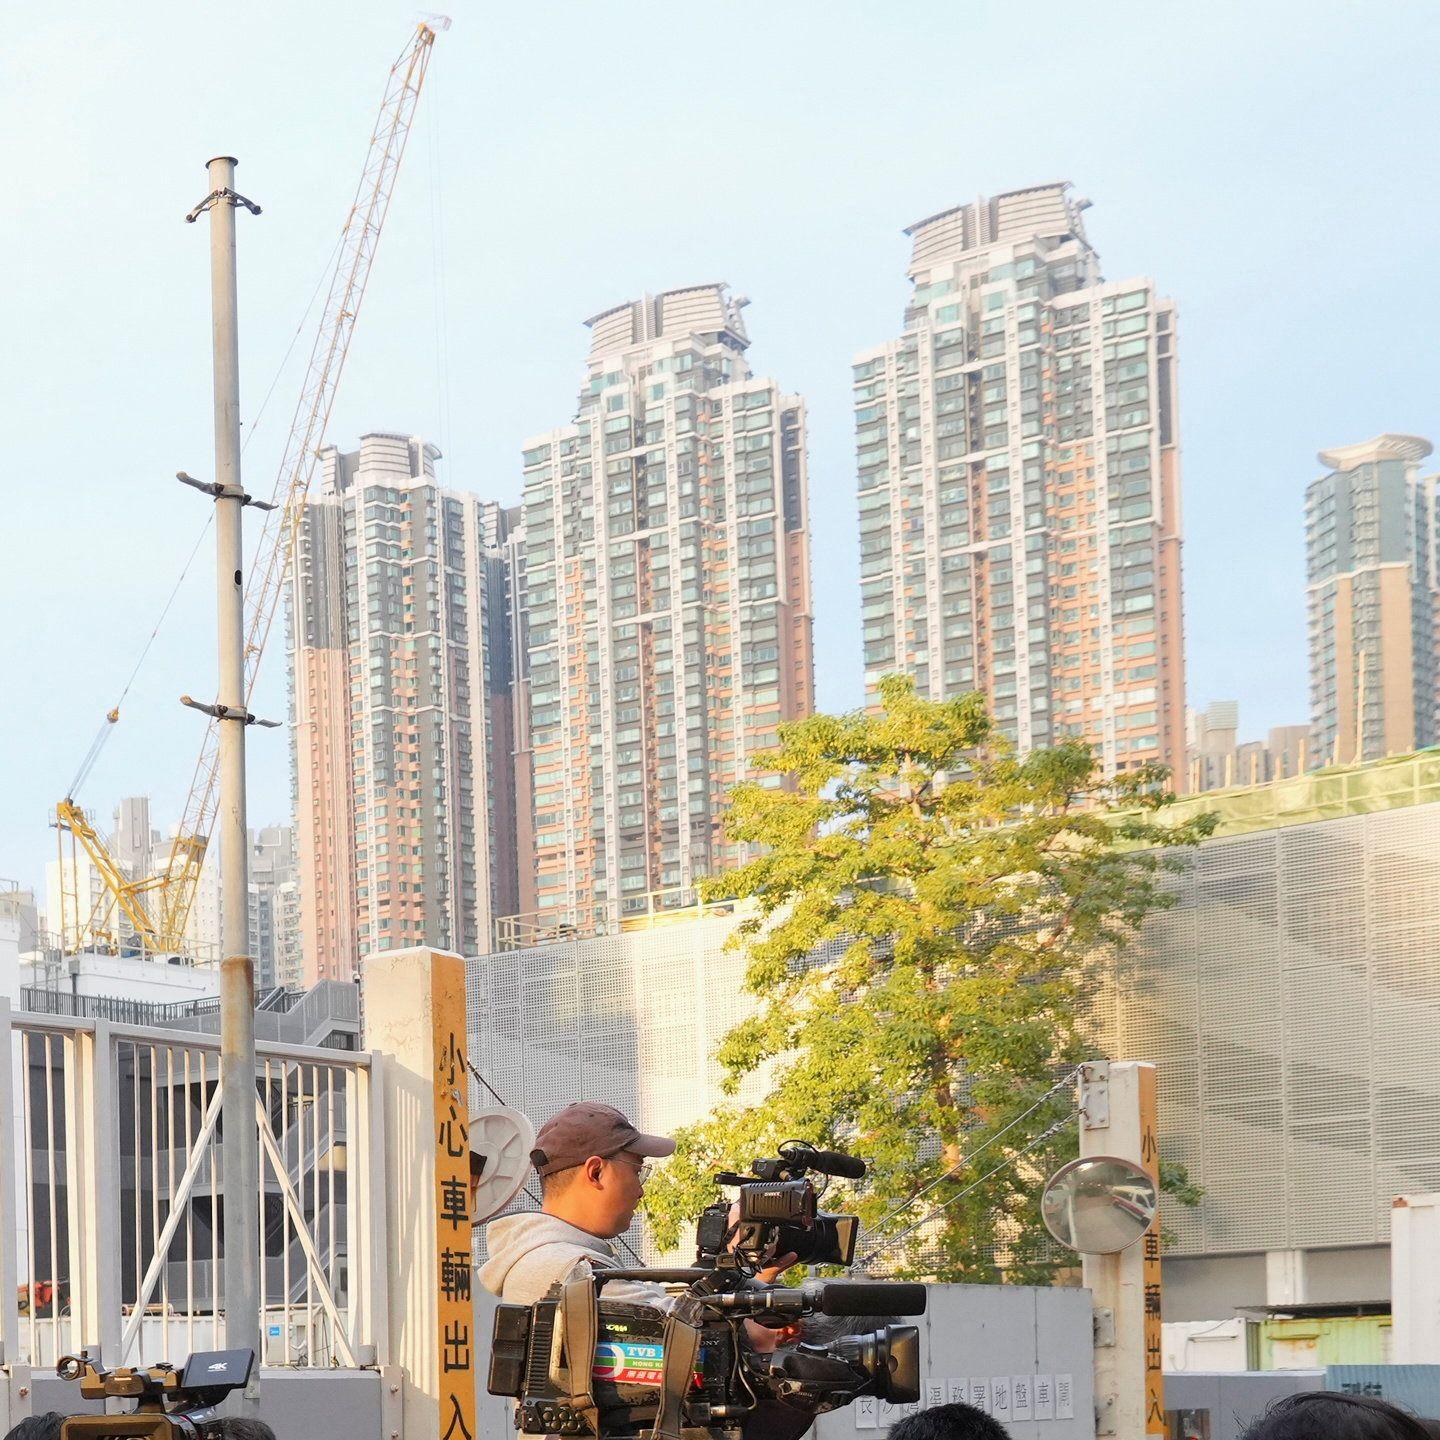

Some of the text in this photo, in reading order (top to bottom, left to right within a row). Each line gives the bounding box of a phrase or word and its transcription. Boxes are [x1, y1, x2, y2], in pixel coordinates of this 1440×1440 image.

[1141, 1125, 1167, 1428] 小車輛出入
[626, 1347, 656, 1357] TVB
[207, 1362, 228, 1371] 4K
